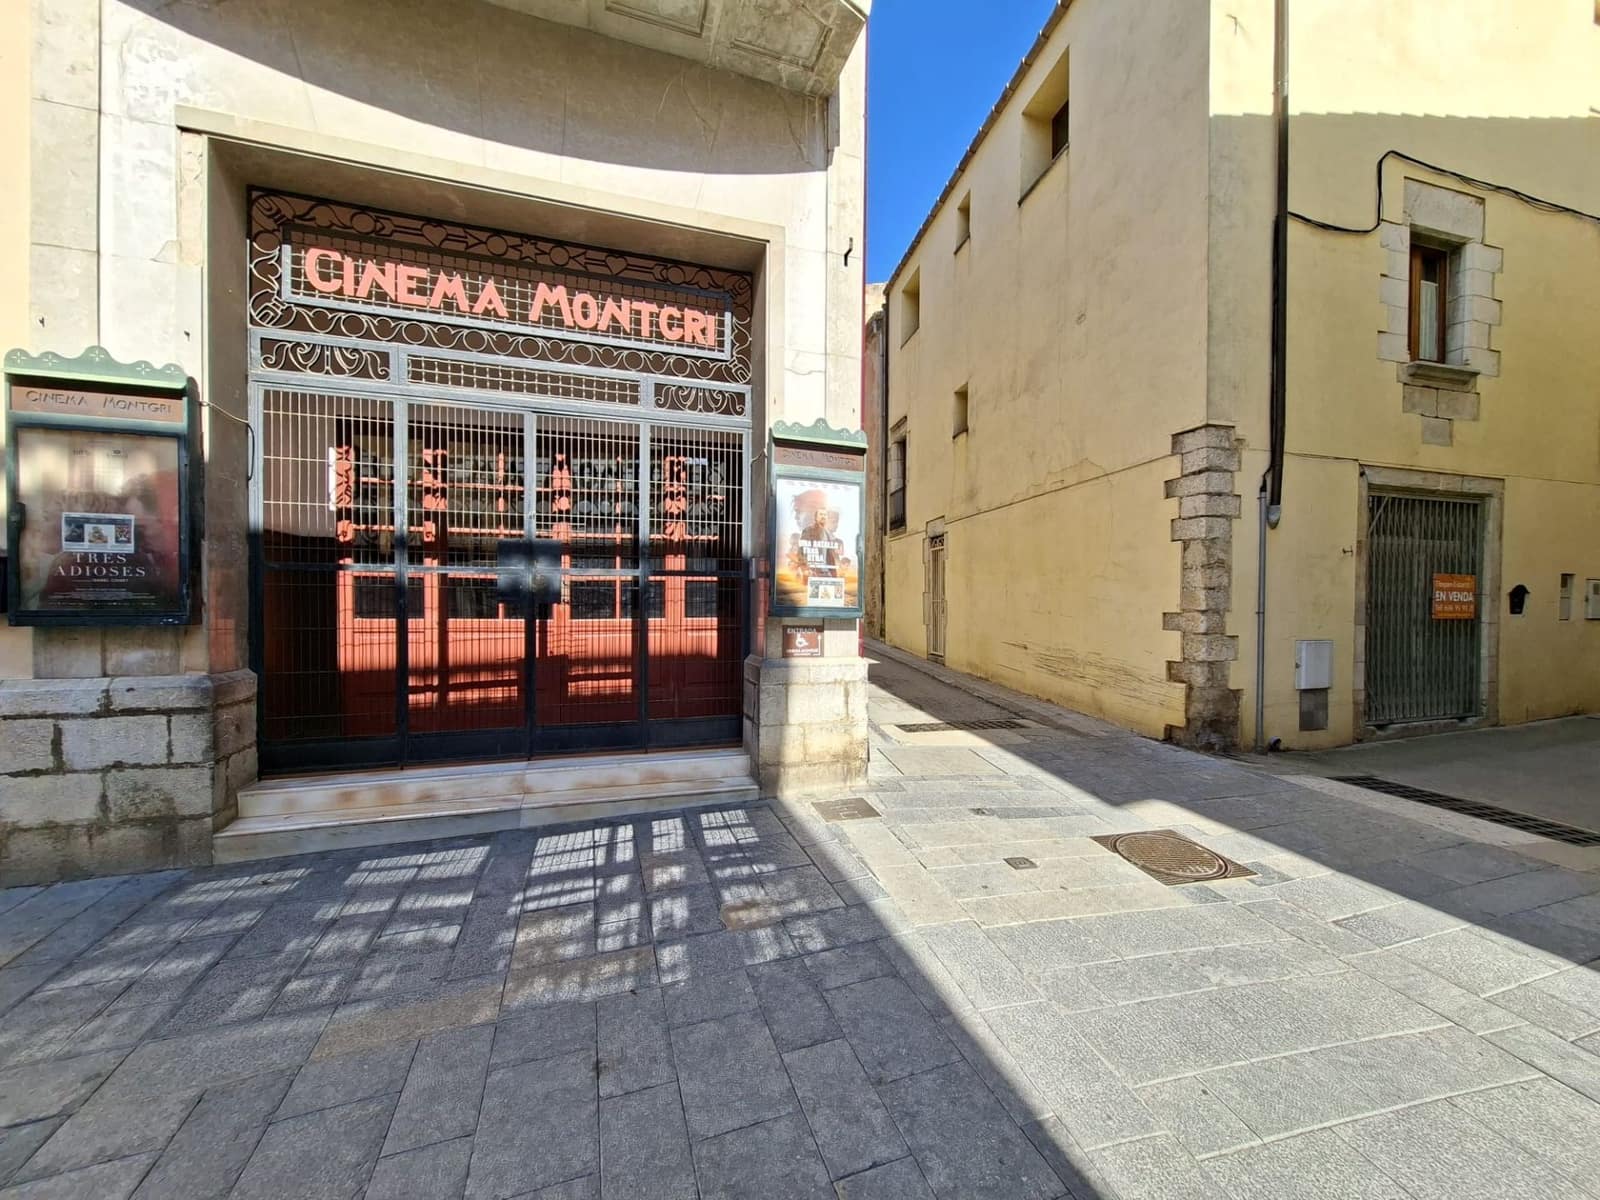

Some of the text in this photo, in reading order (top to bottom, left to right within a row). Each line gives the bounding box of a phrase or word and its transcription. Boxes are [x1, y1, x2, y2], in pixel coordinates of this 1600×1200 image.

[304, 247, 717, 348] CINEMA MONTGRI
[25, 390, 172, 413] CINEMA MONTGRI
[72, 552, 127, 564] TRES
[55, 566, 146, 577] ADIOSES
[1435, 591, 1474, 602] EN VENDA
